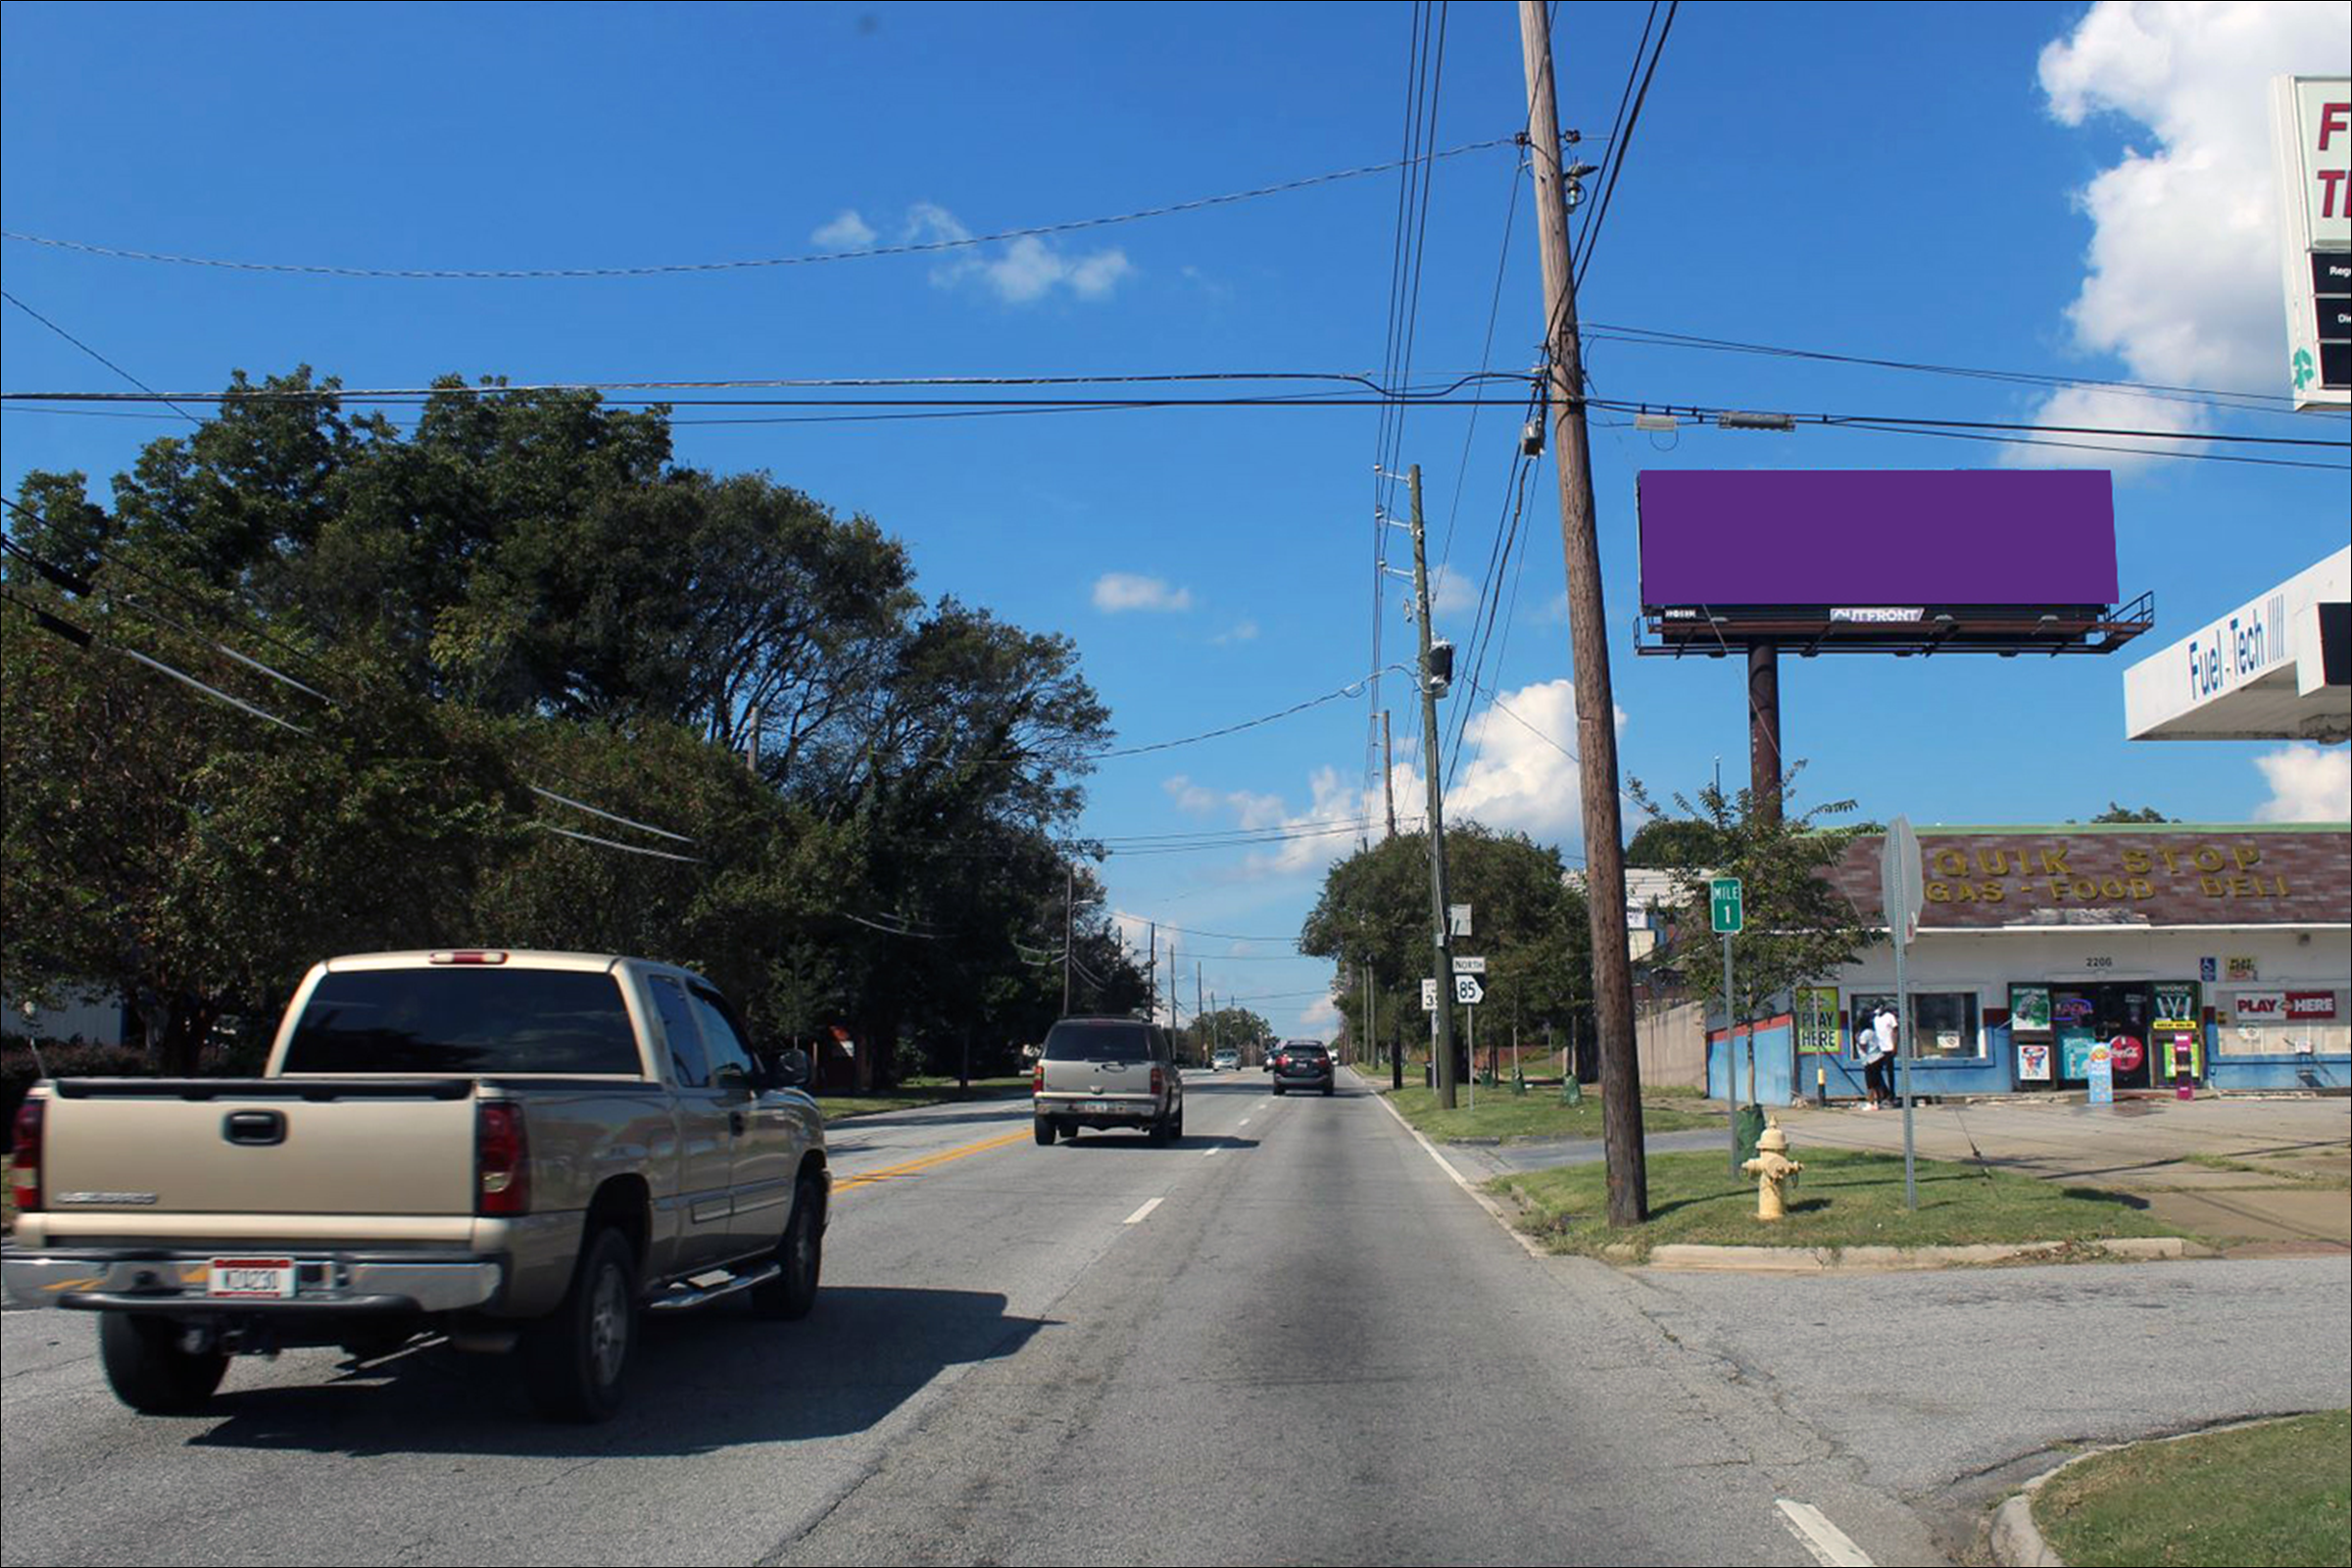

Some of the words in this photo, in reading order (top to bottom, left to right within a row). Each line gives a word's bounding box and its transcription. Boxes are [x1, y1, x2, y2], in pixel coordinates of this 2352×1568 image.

[1934, 845, 2075, 877] QUIK
[2121, 844, 2261, 874] STOP
[1713, 886, 1740, 901] MILE
[1926, 881, 2006, 904] GAS
[2048, 877, 2155, 901] FOOD
[2199, 874, 2290, 898] DELI
[1723, 905, 1732, 925] 1
[1454, 959, 1483, 970] NORTH
[1458, 981, 1477, 1000] 85
[2236, 998, 2278, 1013] PLAY
[2293, 998, 2334, 1012] HERE
[1801, 1011, 1834, 1027] PLAY
[1801, 1030, 1836, 1047] HERE
